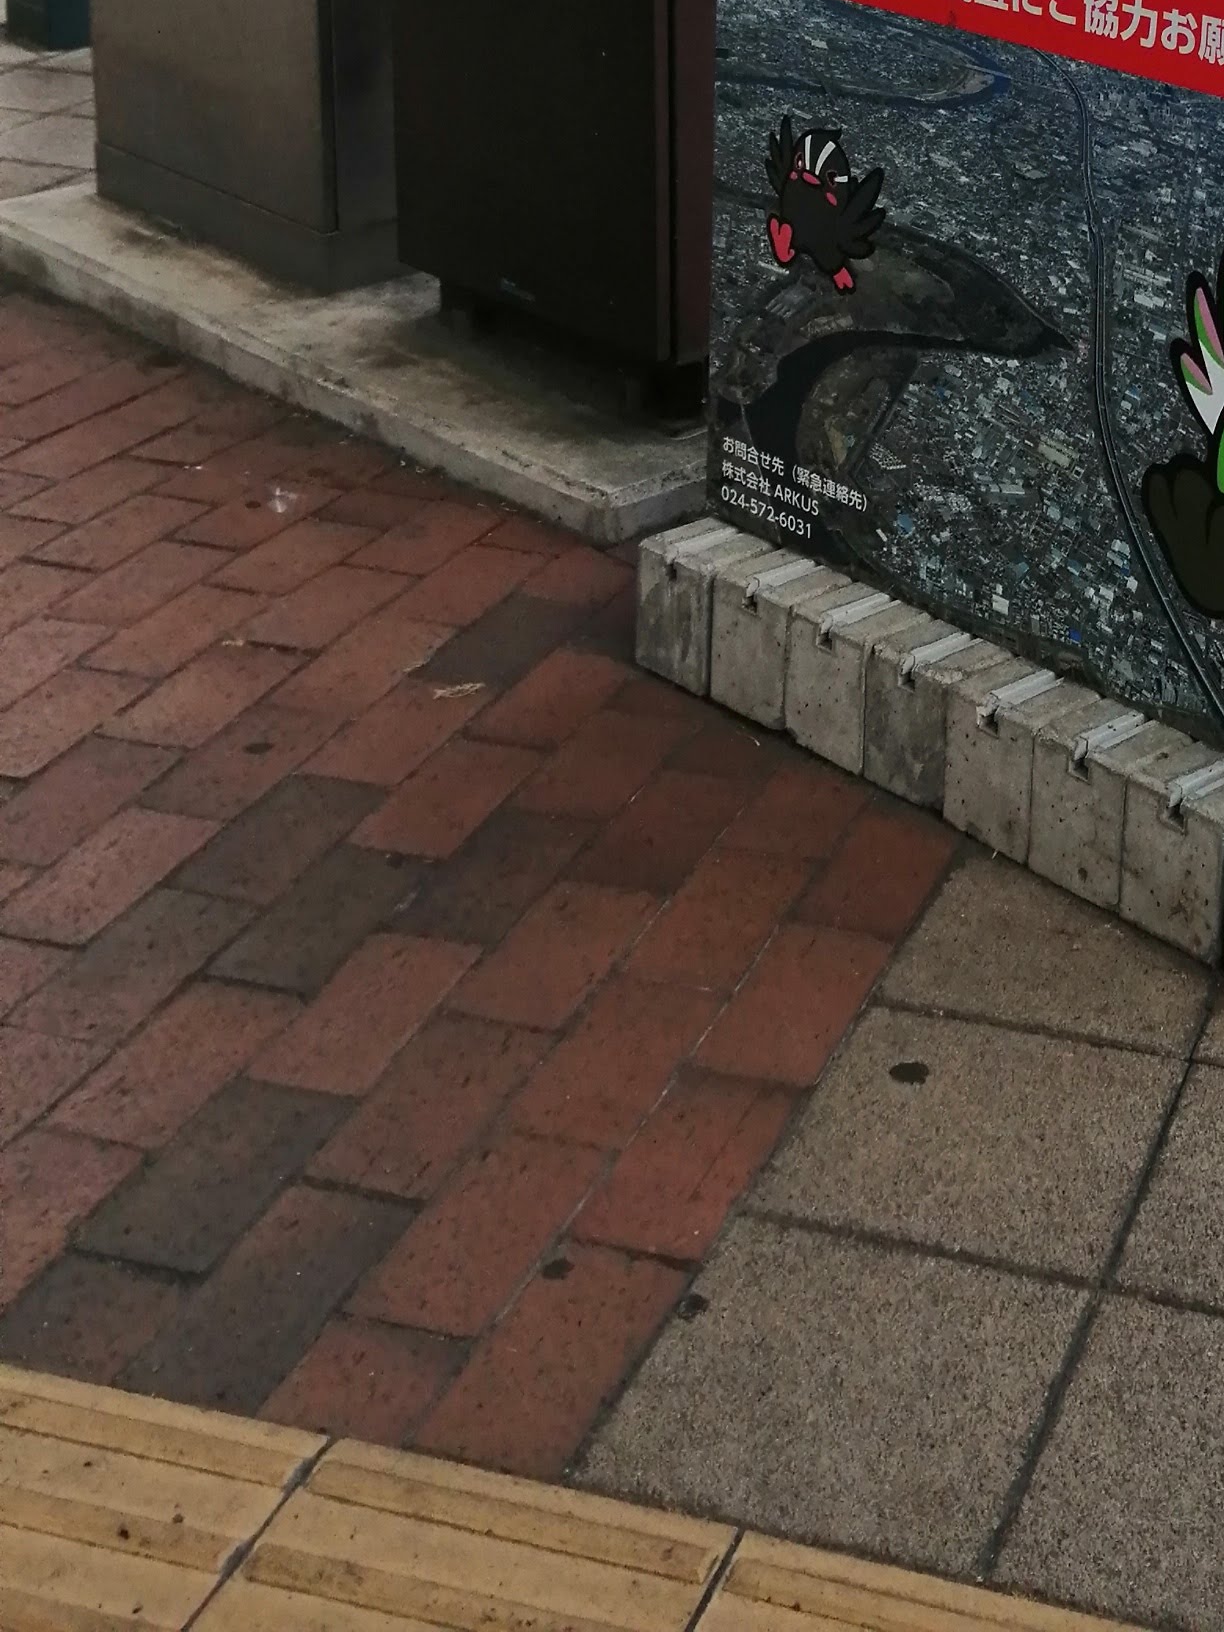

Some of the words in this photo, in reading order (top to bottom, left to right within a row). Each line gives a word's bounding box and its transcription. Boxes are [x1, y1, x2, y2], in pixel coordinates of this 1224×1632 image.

[720, 485, 812, 539] 024-572-6031
[721, 459, 772, 497] 株式会社
[773, 484, 820, 517] ARKUS
